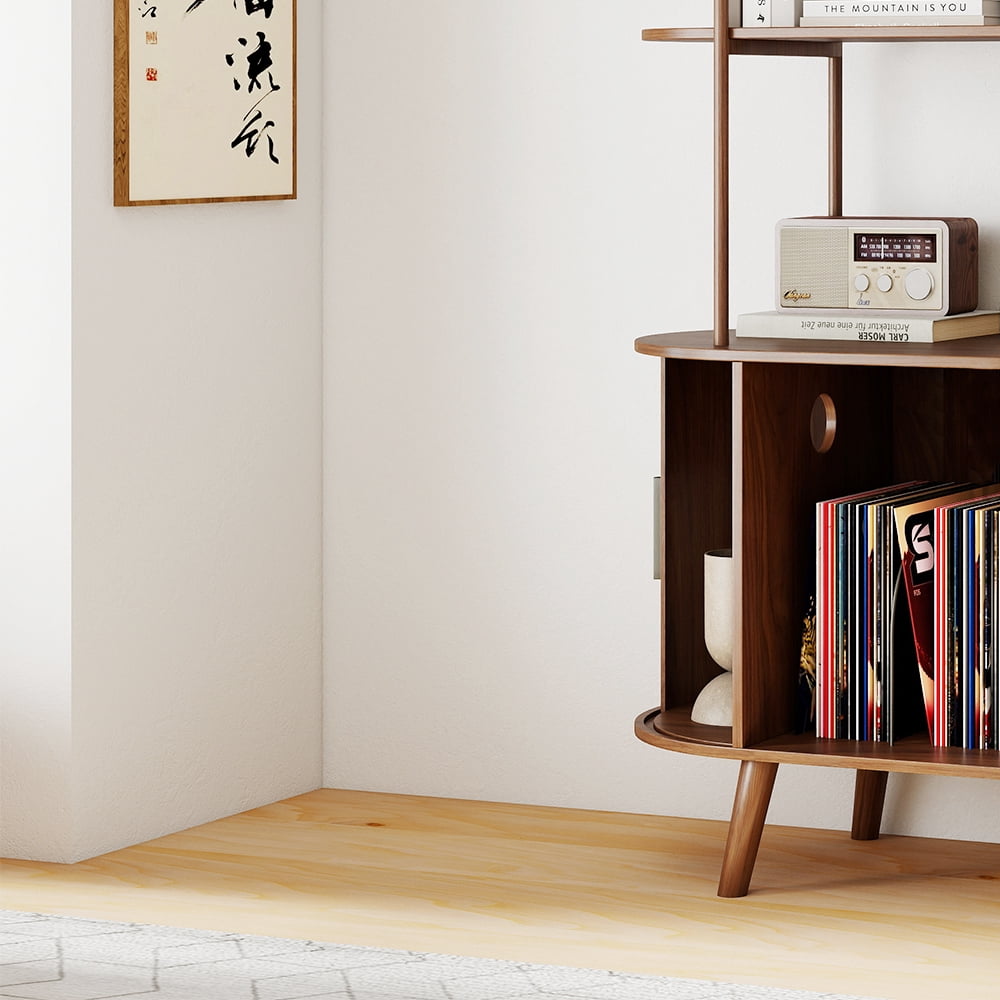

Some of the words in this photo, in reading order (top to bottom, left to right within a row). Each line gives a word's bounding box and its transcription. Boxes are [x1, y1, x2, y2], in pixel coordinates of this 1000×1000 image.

[825, 5, 845, 13] THE
[851, 4, 919, 13] MOUNTAIN
[924, 3, 936, 12] IS
[940, 3, 967, 12] YOU
[801, 320, 816, 330] Zeit
[817, 320, 836, 328] neue
[837, 321, 853, 330] eine
[855, 322, 866, 331] für
[868, 322, 910, 332] Architektur
[858, 332, 886, 340] MOSER
[888, 332, 909, 341] CARL
